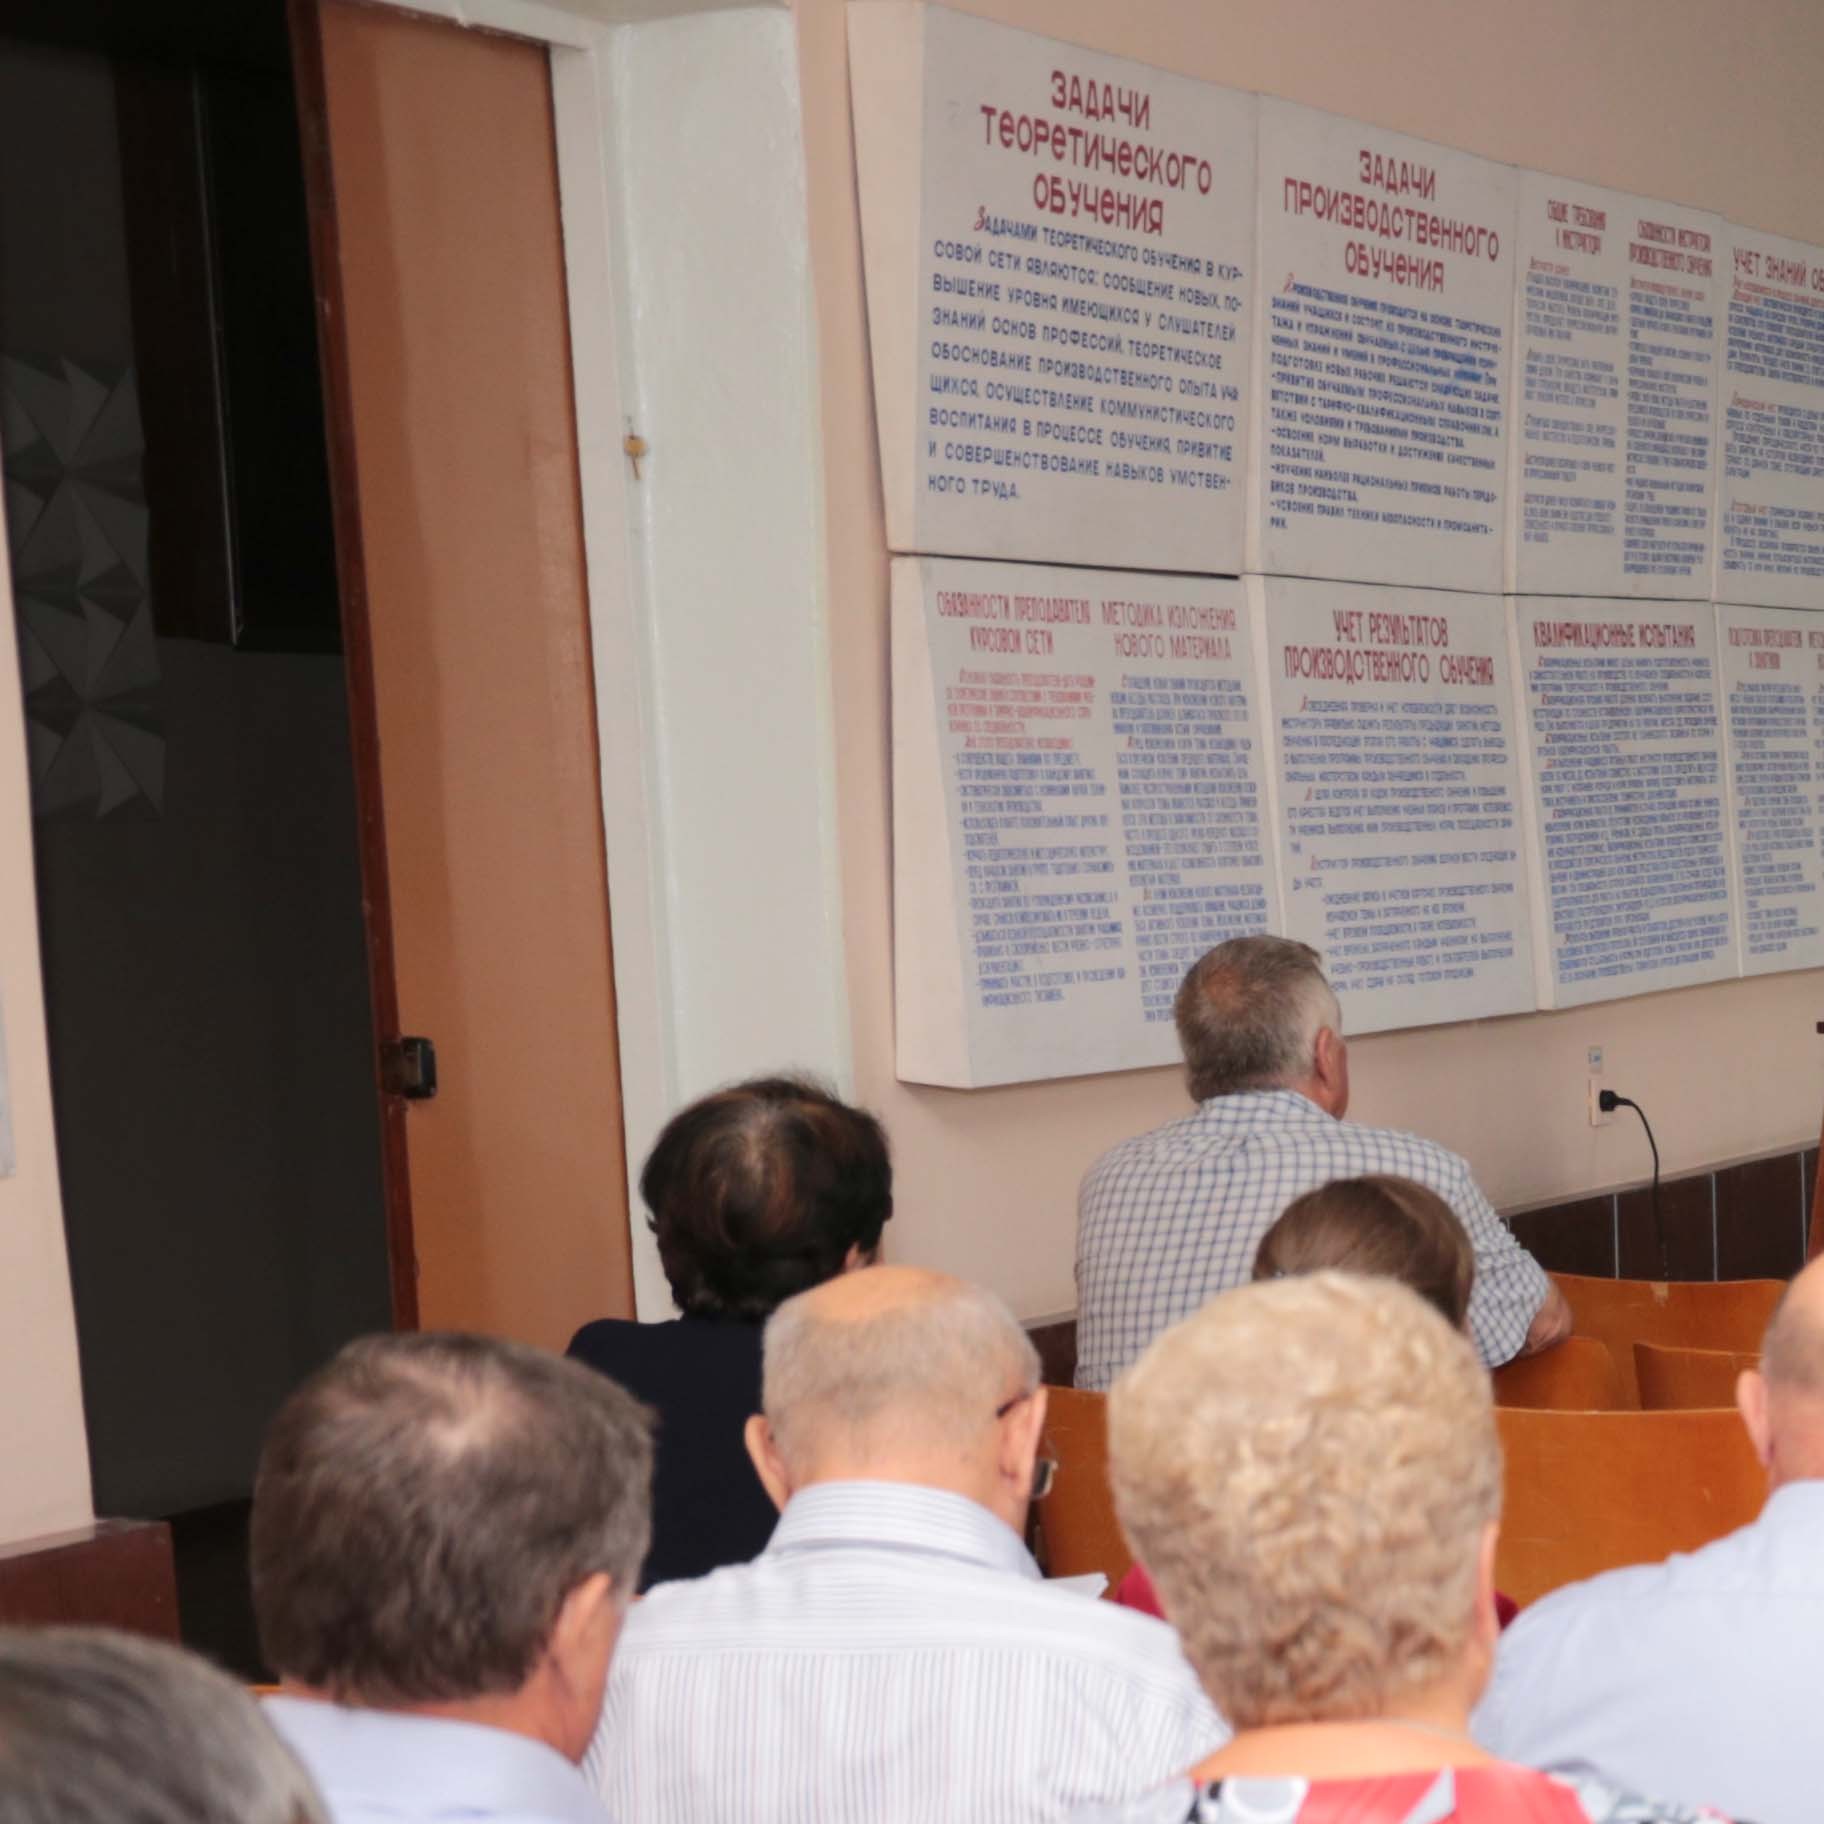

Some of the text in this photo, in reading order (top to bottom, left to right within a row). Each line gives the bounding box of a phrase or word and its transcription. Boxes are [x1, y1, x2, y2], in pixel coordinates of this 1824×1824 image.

[1050, 70, 1149, 129] ЗАДАЧИ
[980, 105, 1211, 194] ТЕОРЕТИЧЕСКОГО
[1359, 150, 1434, 199] ЗАДАЧИ
[1033, 173, 1163, 234] ОБУЧЕНИЯ
[1284, 178, 1498, 260] ПРОИЗВОДСТВЕННОГО
[933, 239, 981, 262] СОВОЙ
[988, 249, 1020, 269] СЕТИ
[1103, 272, 1173, 300] СООБЩЕНИЕ
[1042, 227, 1137, 261] ТЕОРЕТИЧЕСКОГО
[1142, 248, 1201, 274] ОБУЧЕНИЯ
[1205, 260, 1214, 277] В
[1345, 241, 1443, 290] ОБУЧЕНИЯ
[1733, 247, 1760, 275] УЧЕТ
[1765, 255, 1806, 286] ЗНАНИЙ
[932, 273, 1235, 340] ВЫШЕНИЕ УРОВНЯ ИМЕЮЩИХСЯ У СЛУШАТЕЛЕЙ
[932, 306, 985, 330] ЗНАНИЙ
[991, 316, 1036, 339] ОСНОВ
[1128, 339, 1221, 369] ТЕОРЕТИЧЕСКОЕ
[931, 341, 1031, 371] ОБОСНОВАНИЕ
[1038, 357, 1172, 391] ПРОИЗВОДСТВЕННОГО
[1179, 378, 1216, 398] ОПЫТА
[985, 382, 1092, 412] ОСУЩЕСТВЛЕНИЕ
[1100, 399, 1234, 430] КОММУНИСТИЧЕСКОГО
[929, 407, 1016, 432] ВОСПИТАНИЯ
[1022, 418, 1031, 436] В
[1036, 420, 1102, 445] ПРОЦЕССЕ
[1177, 439, 1231, 461] ПРИВИТИЕ
[928, 440, 936, 456] И
[945, 442, 1098, 475] СОВЕРШЕНСТВОВАНИЕ
[1106, 462, 1163, 482] НАВЫКОВ
[928, 475, 965, 493] НОГО
[1100, 600, 1236, 630] МЕТОДИКА ИЗЛОЖЕНИЯ
[1332, 610, 1448, 647] УЧЕТ РЕЗУЛЬТАТОВ
[1533, 621, 1694, 649] КВАЛИФИКАЦИОННЫЕ ИСПЫТАНИЯ
[1114, 632, 1231, 659] НОВОГО МАТЕРИАЛА
[1284, 645, 1493, 684] ПРОИЗВОДСТВЕННОГО ОБУЧЕНИЯ
